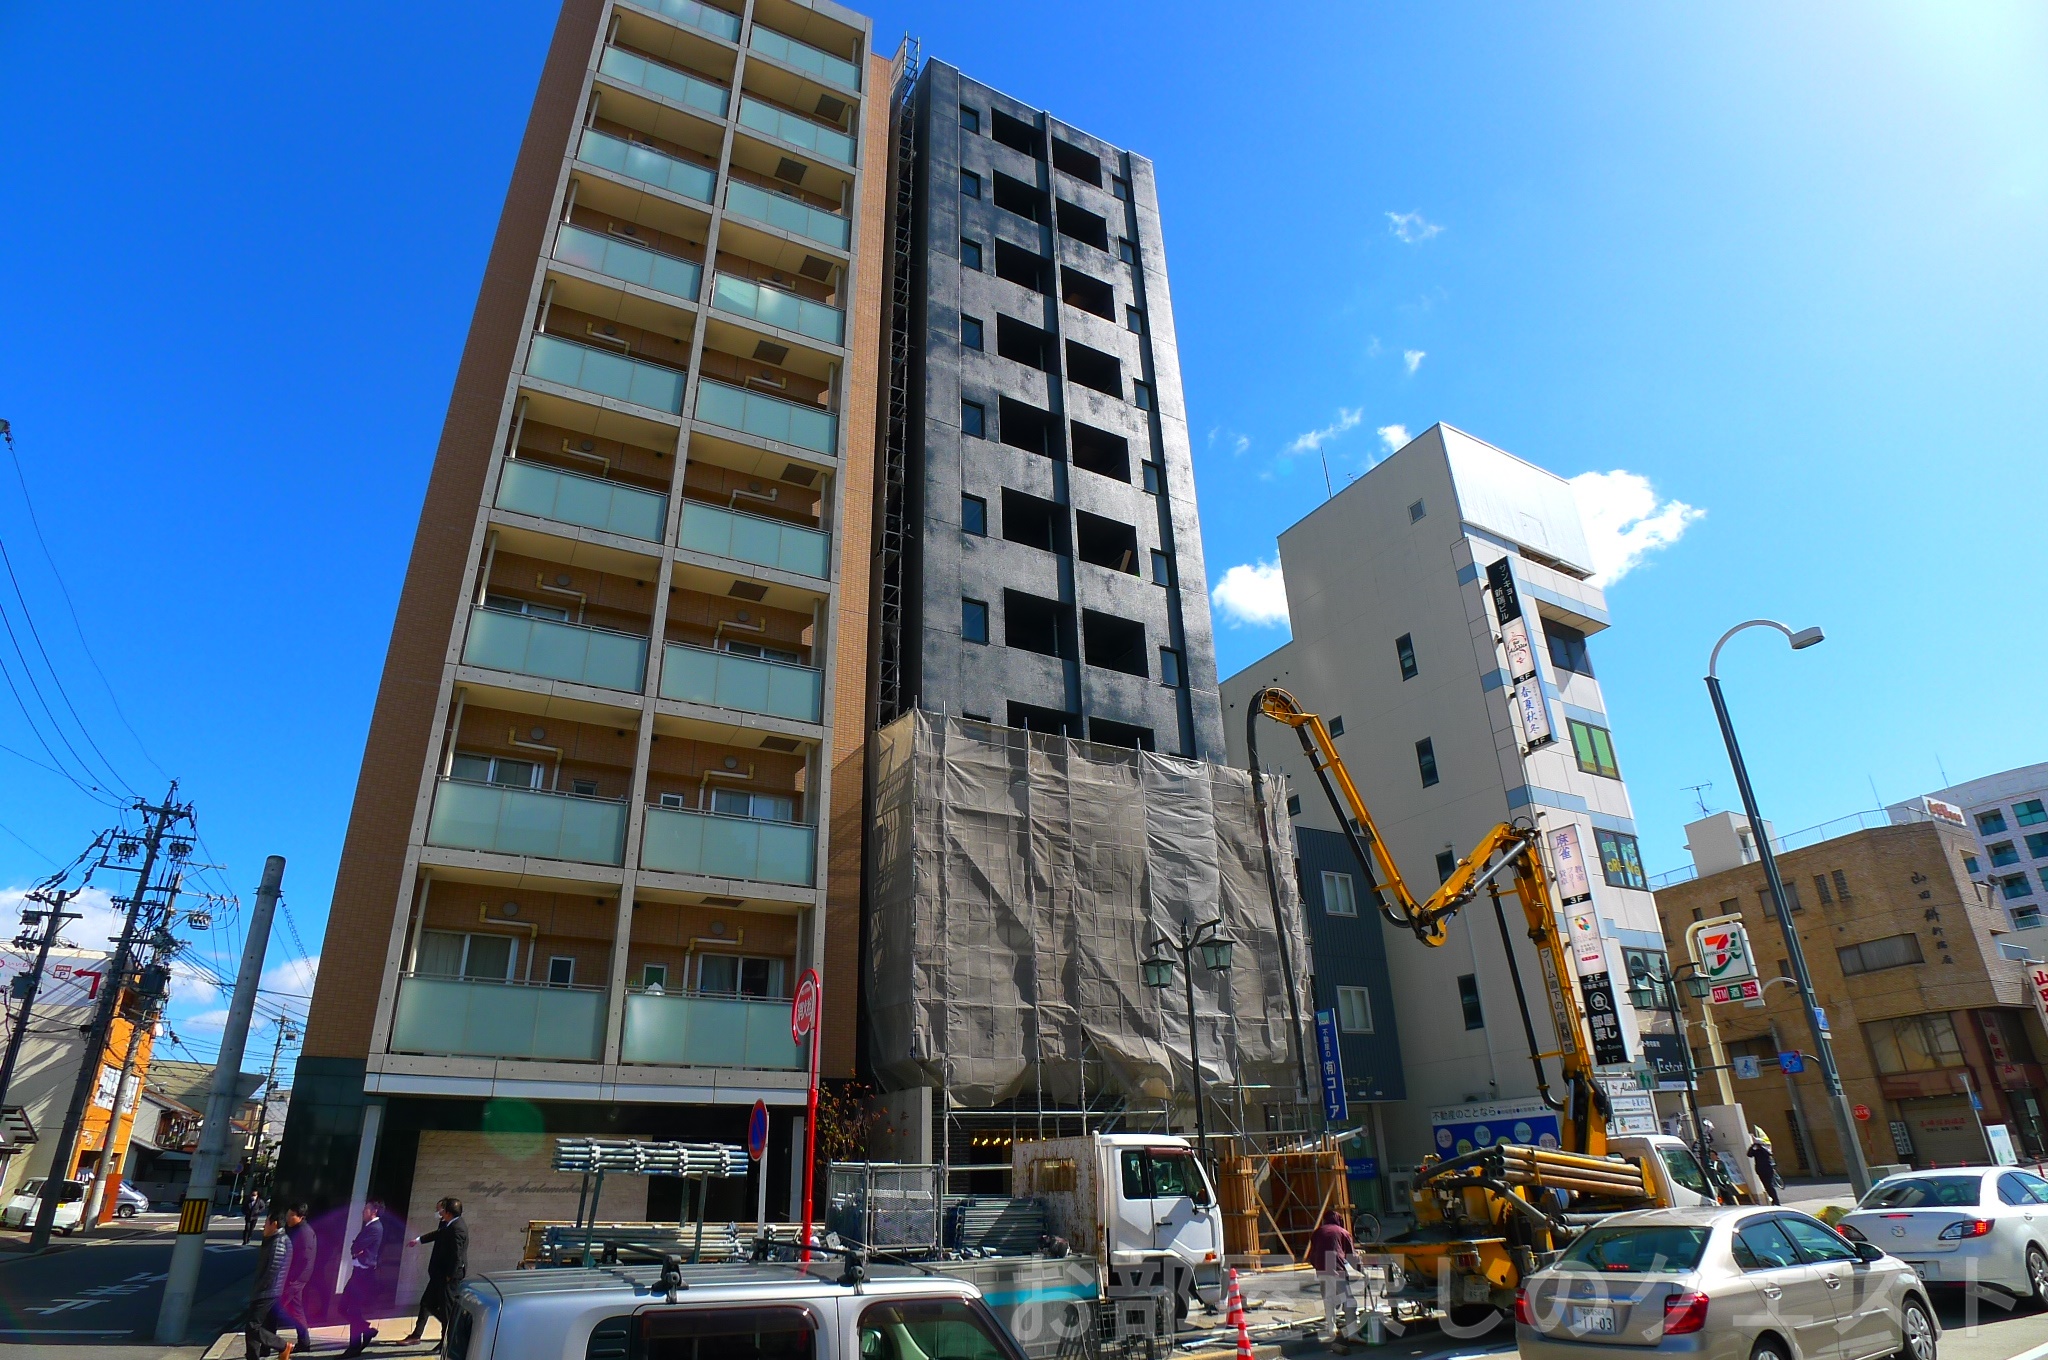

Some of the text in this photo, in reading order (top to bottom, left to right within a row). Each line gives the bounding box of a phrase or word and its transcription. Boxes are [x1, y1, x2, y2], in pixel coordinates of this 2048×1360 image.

[1499, 564, 1513, 604] サンキョー
[1521, 686, 1540, 734] 春夏秋冬
[1556, 833, 1572, 860] 麻雀
[1570, 895, 1583, 904] 3F
[1588, 973, 1601, 982] 2F
[1714, 989, 1729, 1001] ATM
[1592, 1013, 1616, 1028] 部屋
[1594, 1027, 1617, 1041] 探し
[1656, 1058, 1684, 1074] Estat
[1432, 1106, 1497, 1121] 不動産のことなら
